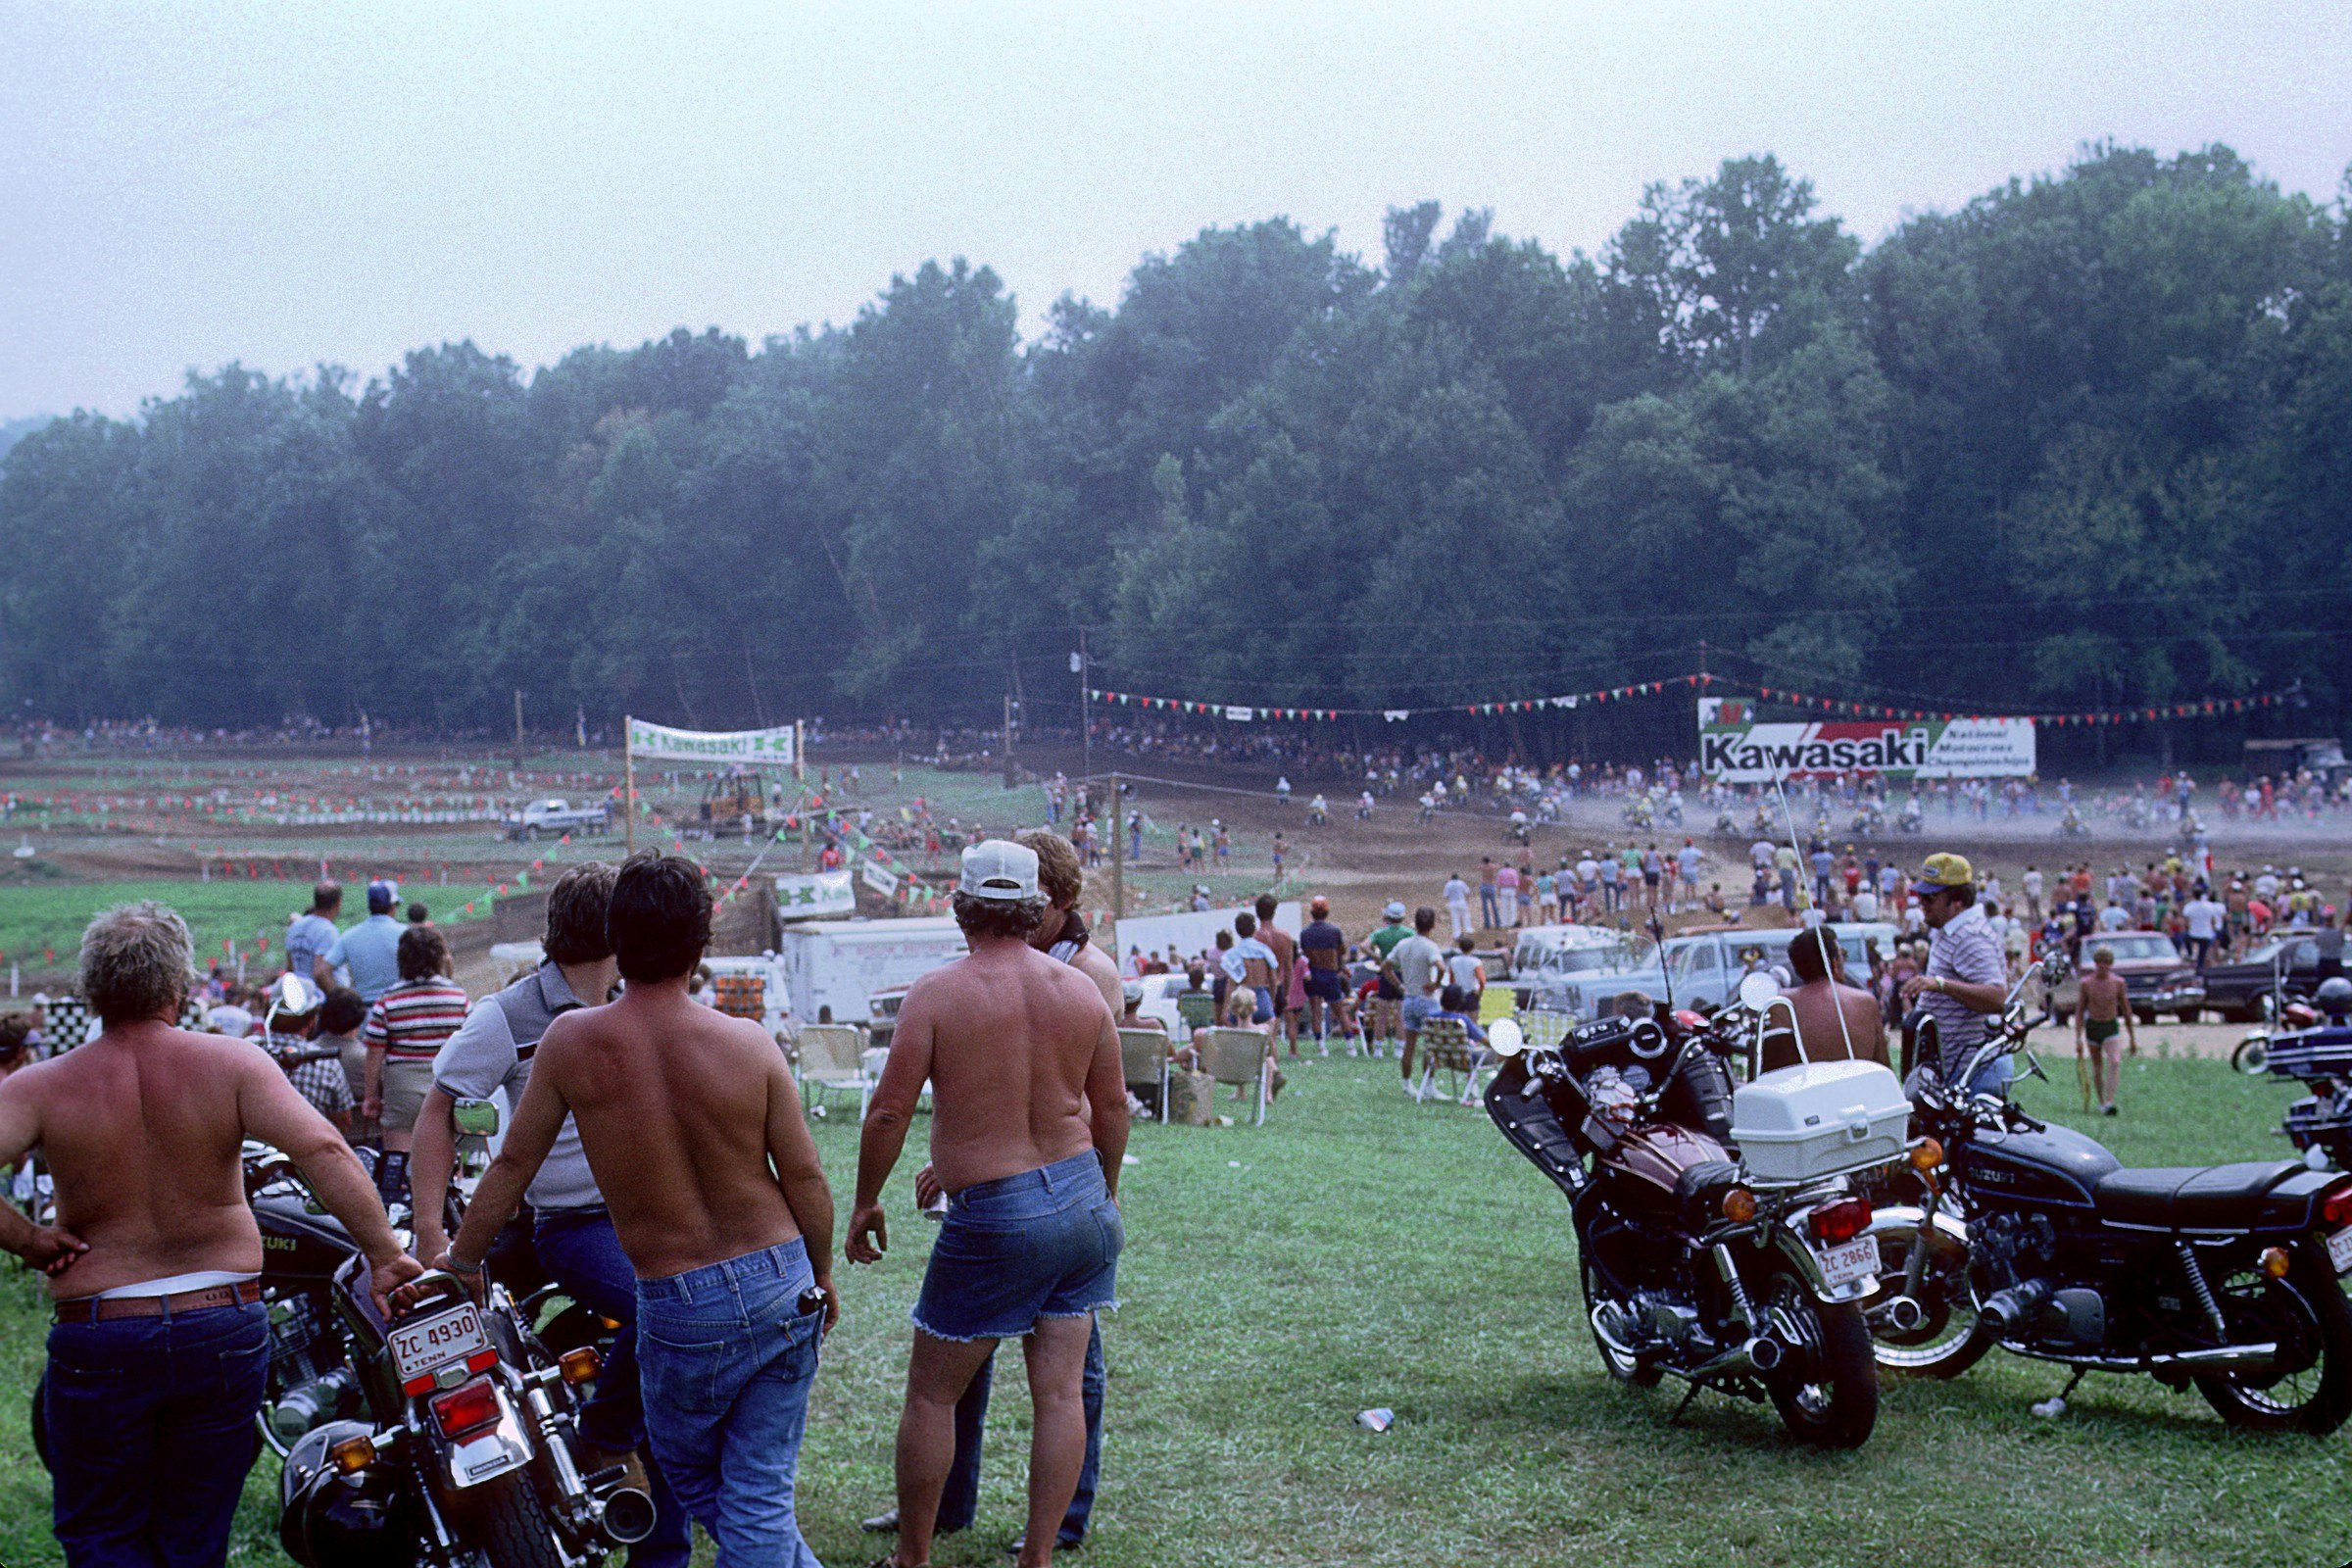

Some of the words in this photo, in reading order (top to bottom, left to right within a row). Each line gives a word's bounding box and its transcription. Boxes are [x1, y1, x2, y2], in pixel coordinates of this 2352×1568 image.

[1705, 732, 1926, 770] Kawasaki
[396, 1335, 423, 1359] ZC
[428, 1315, 474, 1347] 4930
[414, 1350, 447, 1368] TENN
